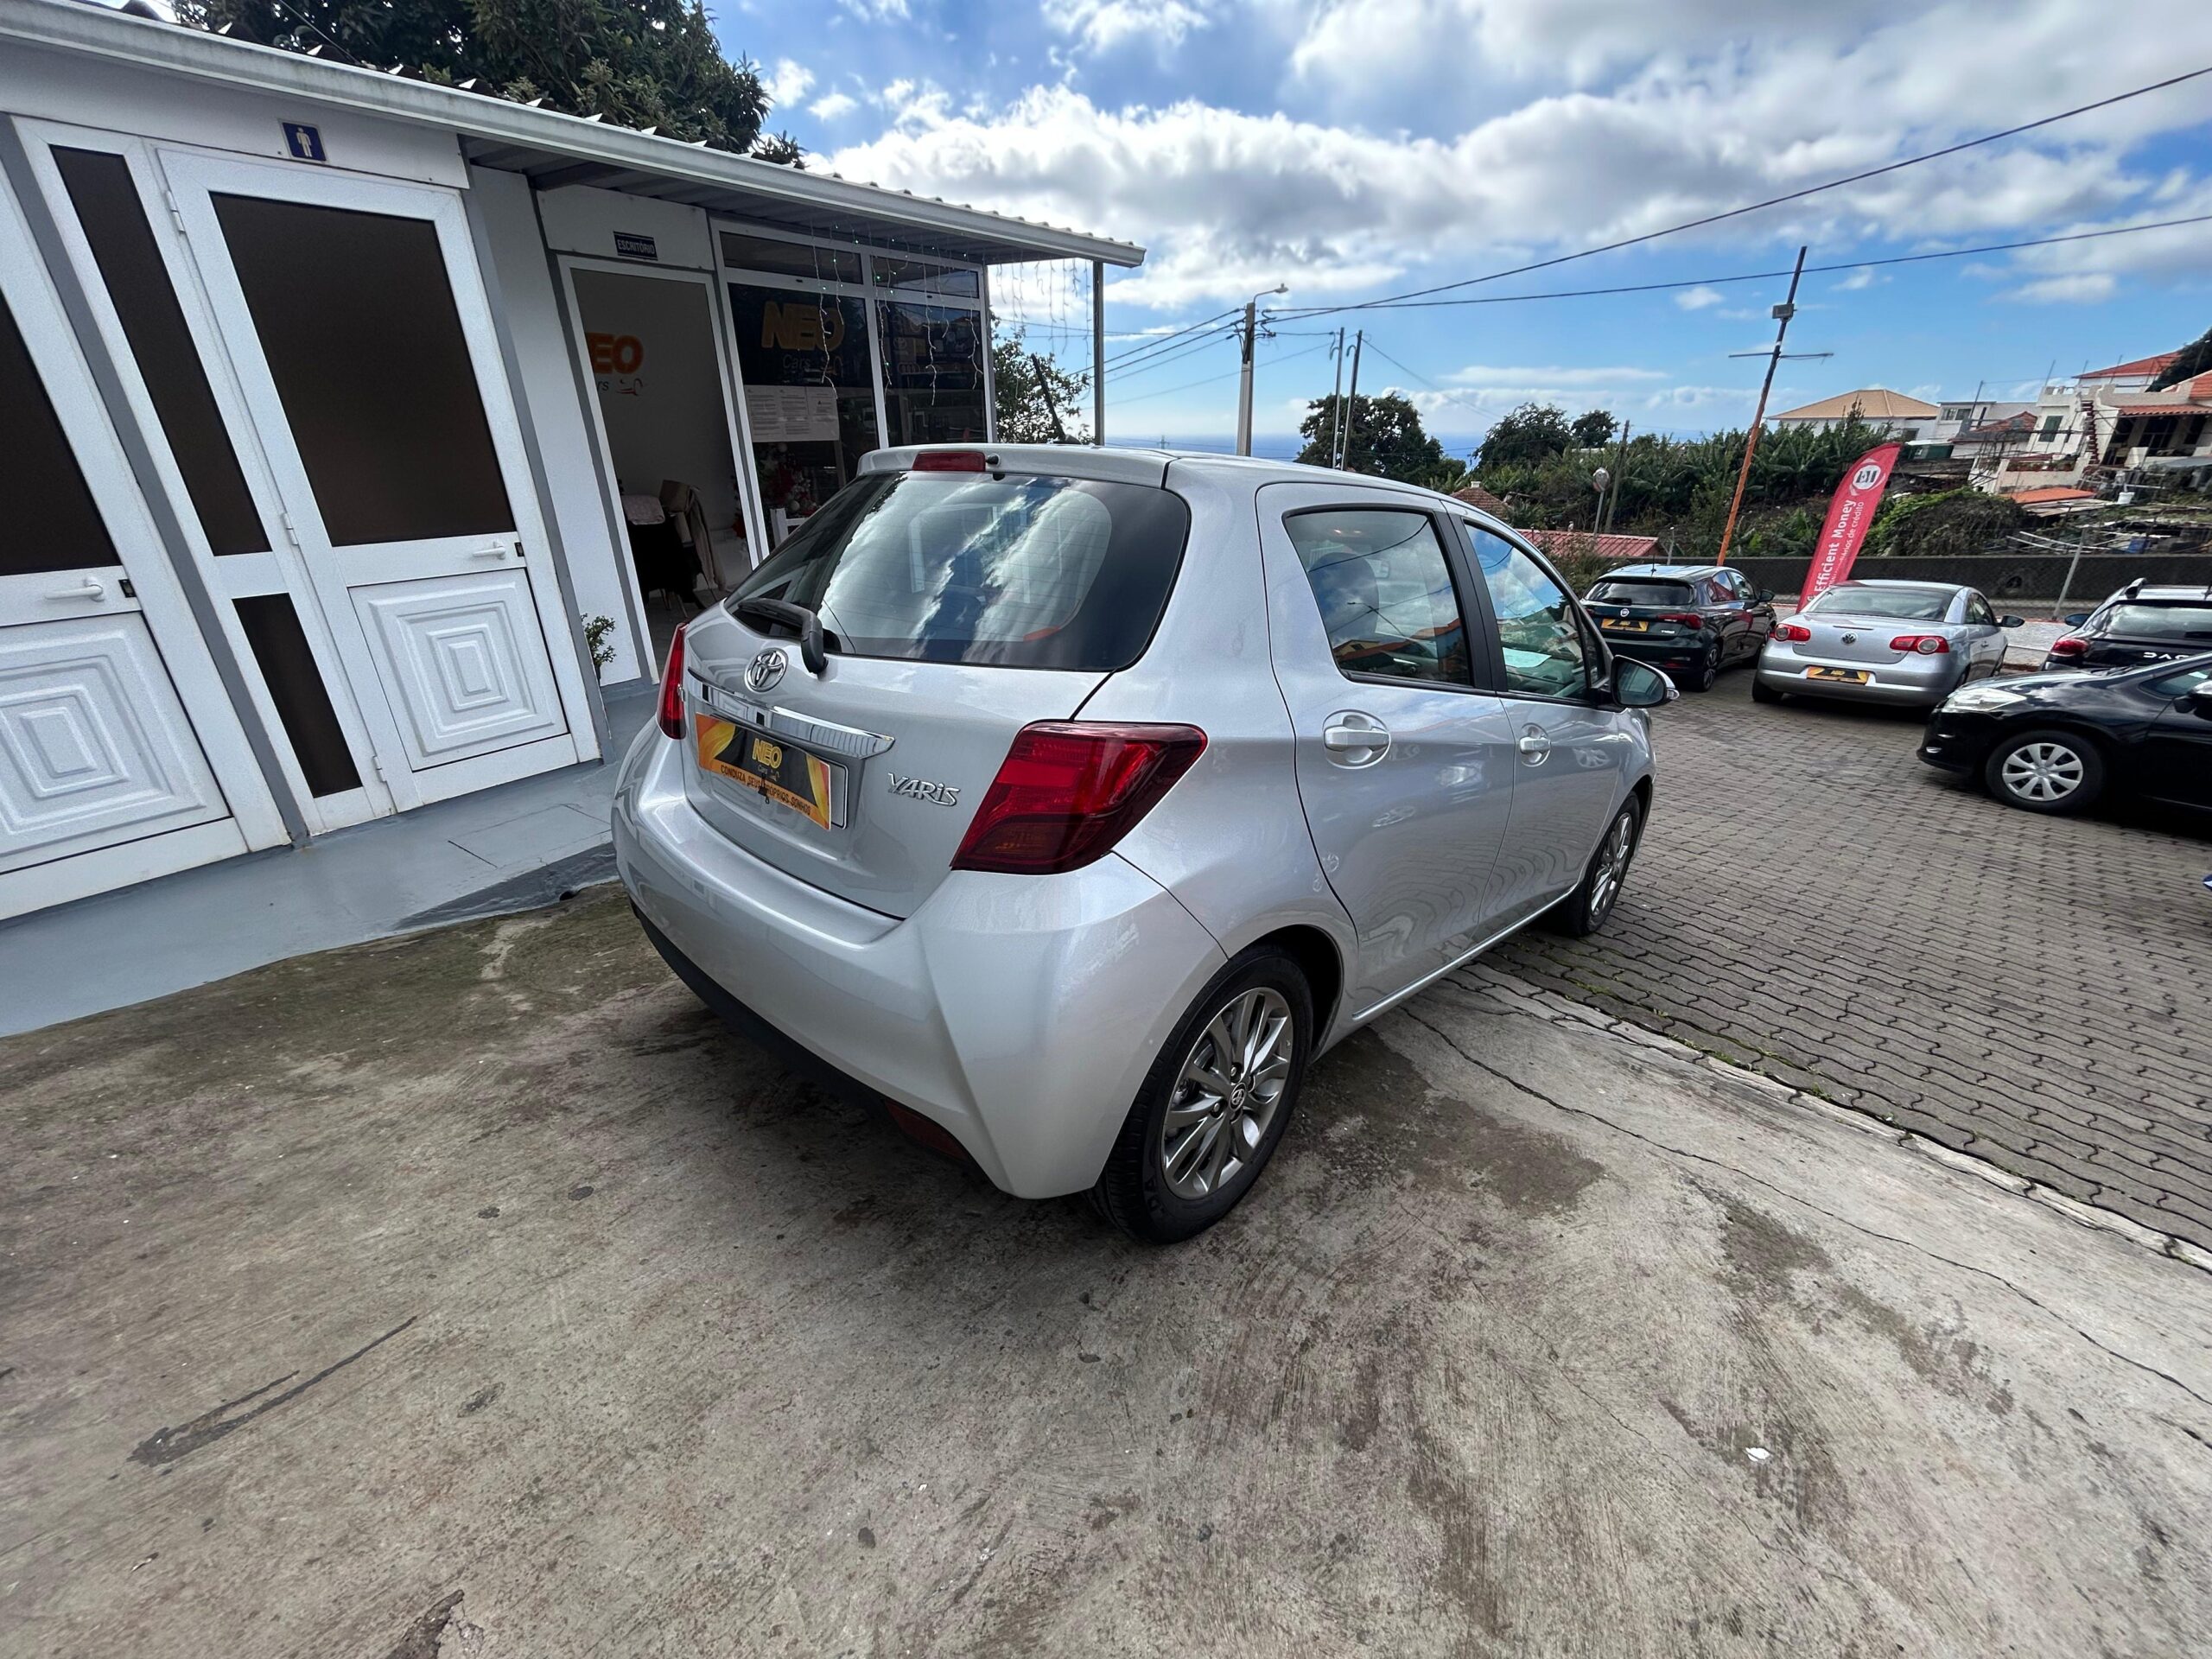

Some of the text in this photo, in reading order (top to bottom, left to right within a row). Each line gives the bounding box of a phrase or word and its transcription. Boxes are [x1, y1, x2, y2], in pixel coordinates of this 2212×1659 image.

[761, 301, 844, 352] NEO
[586, 333, 644, 374] EO
[1815, 499, 1856, 592] Efficient Money
[752, 738, 783, 769] NEO
[721, 765, 747, 783] CONDUZA
[791, 796, 811, 816] SONHOS
